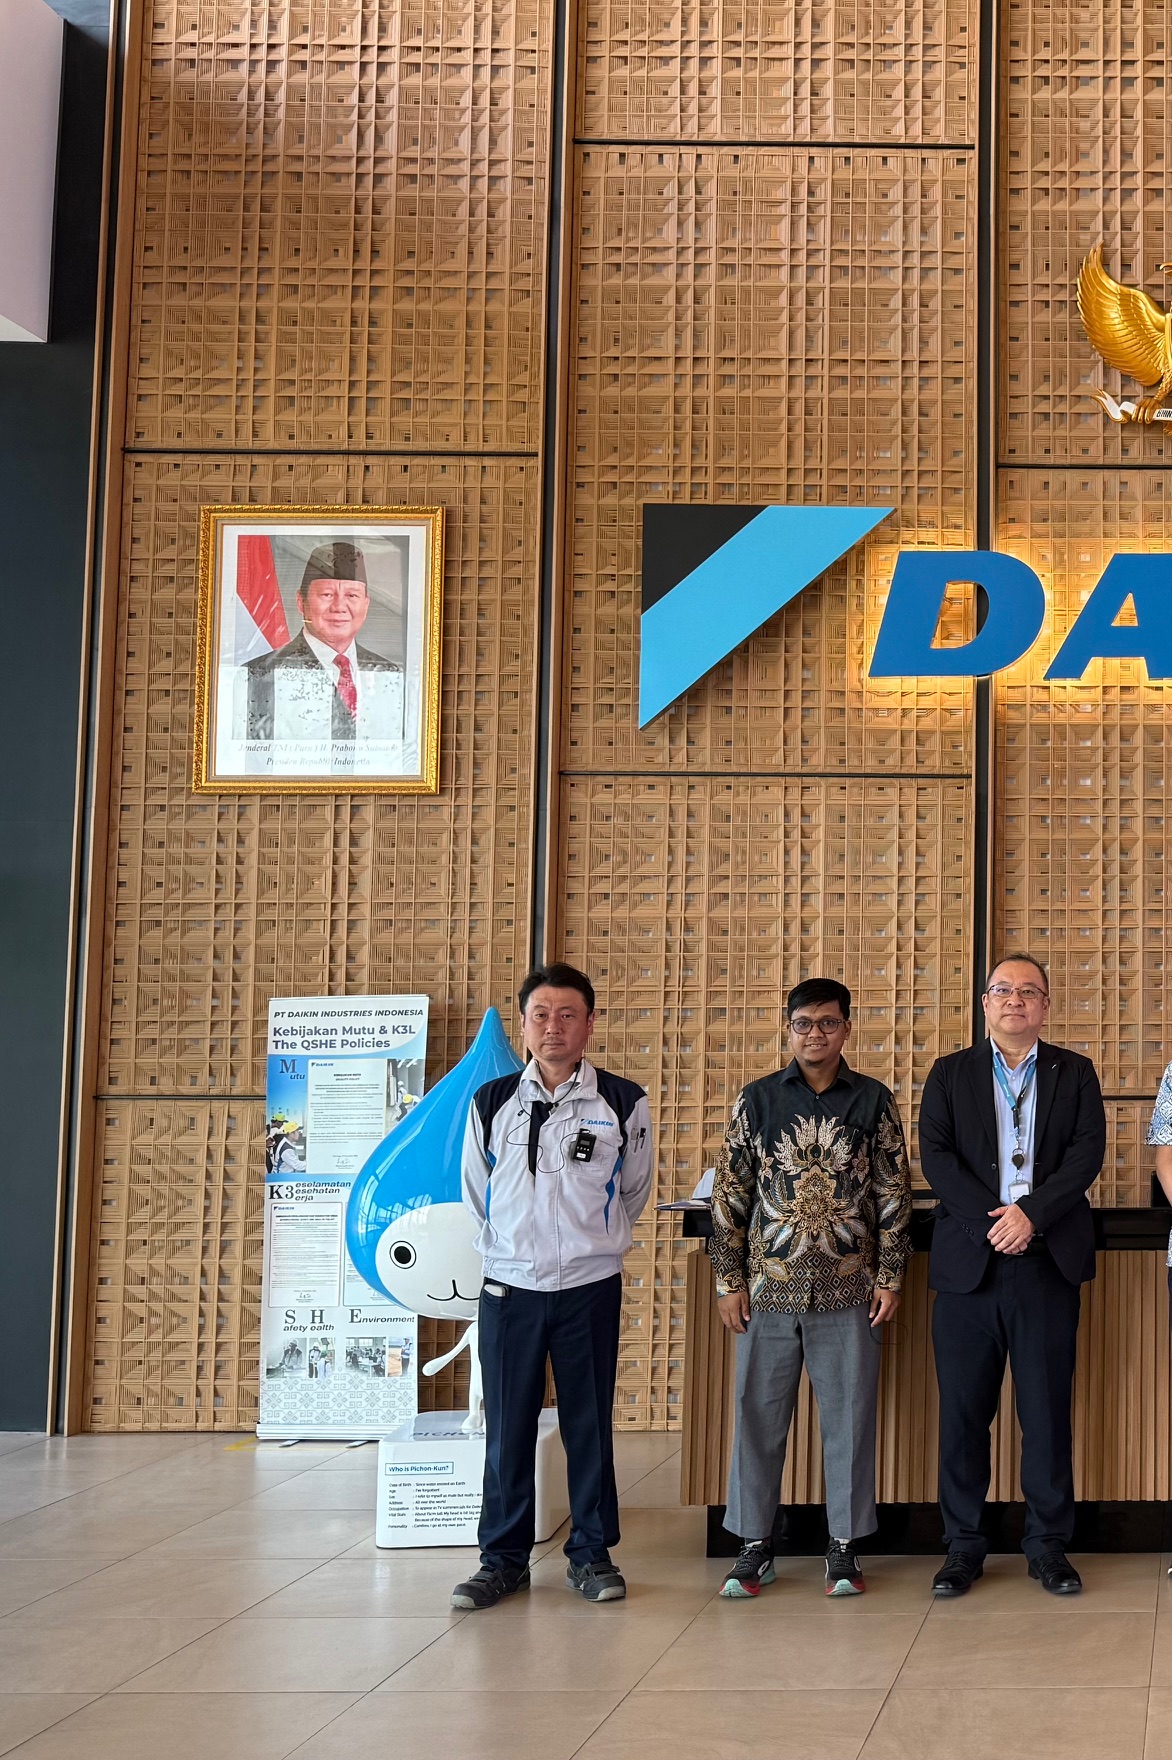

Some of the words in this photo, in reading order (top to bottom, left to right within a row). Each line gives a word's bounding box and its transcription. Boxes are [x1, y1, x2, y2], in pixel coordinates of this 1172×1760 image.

[273, 1026, 338, 1038] Kebijakan
[342, 1026, 375, 1036] Mutu
[378, 1026, 388, 1034] &
[392, 1024, 416, 1034] K3L
[272, 1040, 298, 1050] The
[301, 1040, 336, 1050] QSHE
[341, 1038, 390, 1048] Policies
